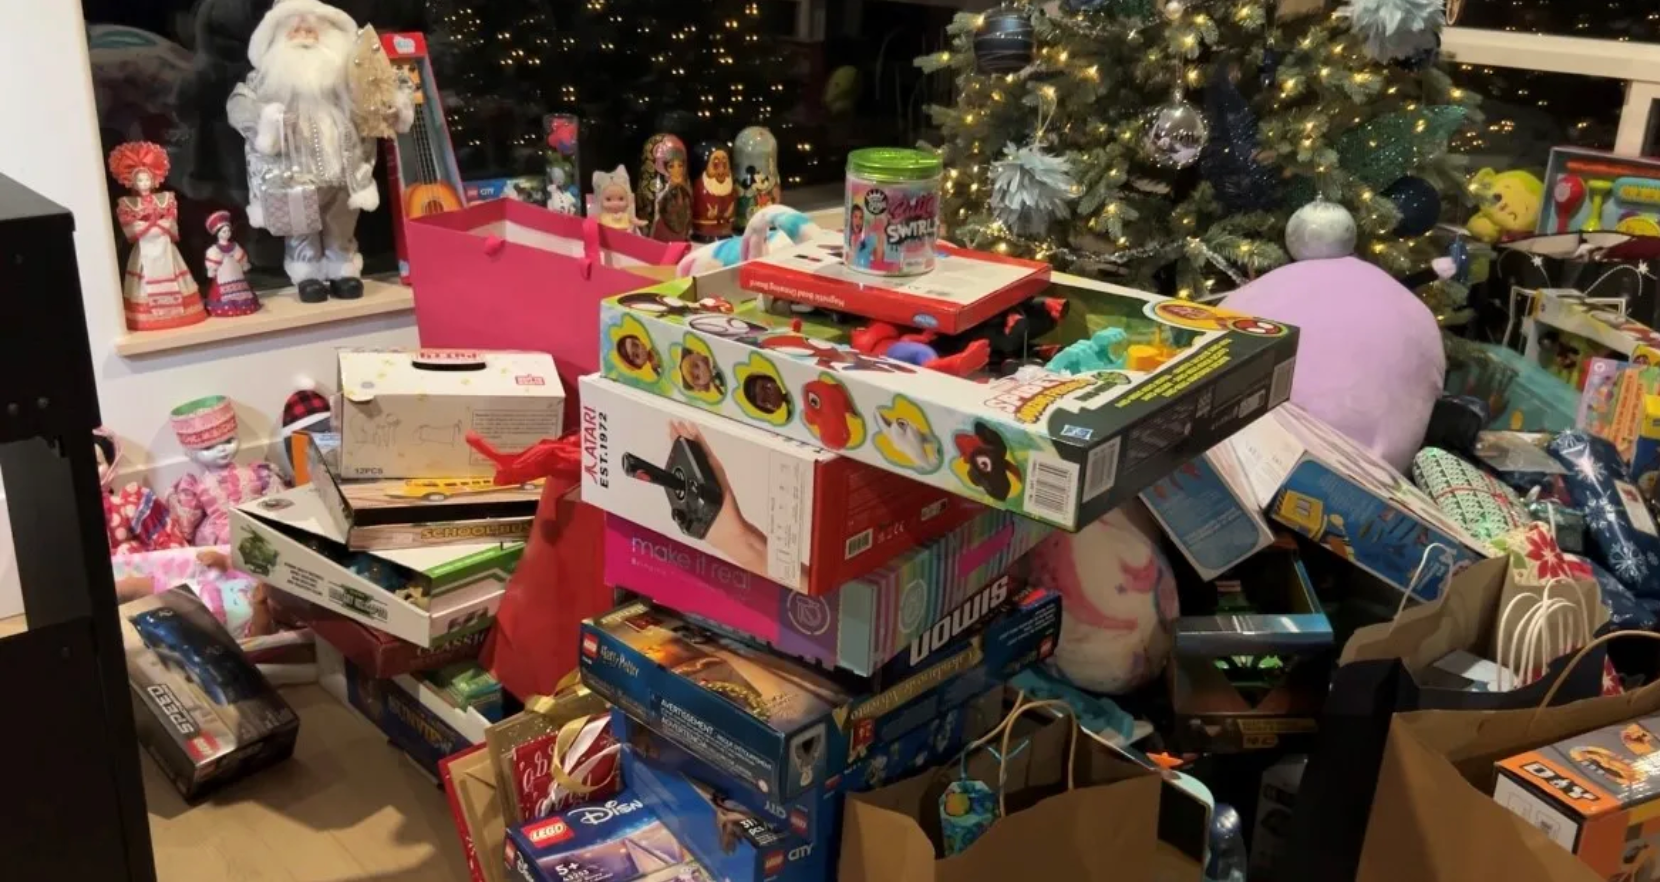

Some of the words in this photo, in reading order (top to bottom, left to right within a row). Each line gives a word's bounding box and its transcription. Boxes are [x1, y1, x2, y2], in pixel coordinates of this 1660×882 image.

[584, 406, 597, 461] ATARI
[600, 412, 609, 488] EST.1972
[421, 526, 494, 540] SCHOOL
[631, 537, 691, 568] make
[148, 686, 195, 734] SPEED
[530, 824, 566, 843] LEGO
[568, 800, 644, 825] Disn
[555, 862, 579, 876] 5+
[788, 842, 814, 861] CITY
